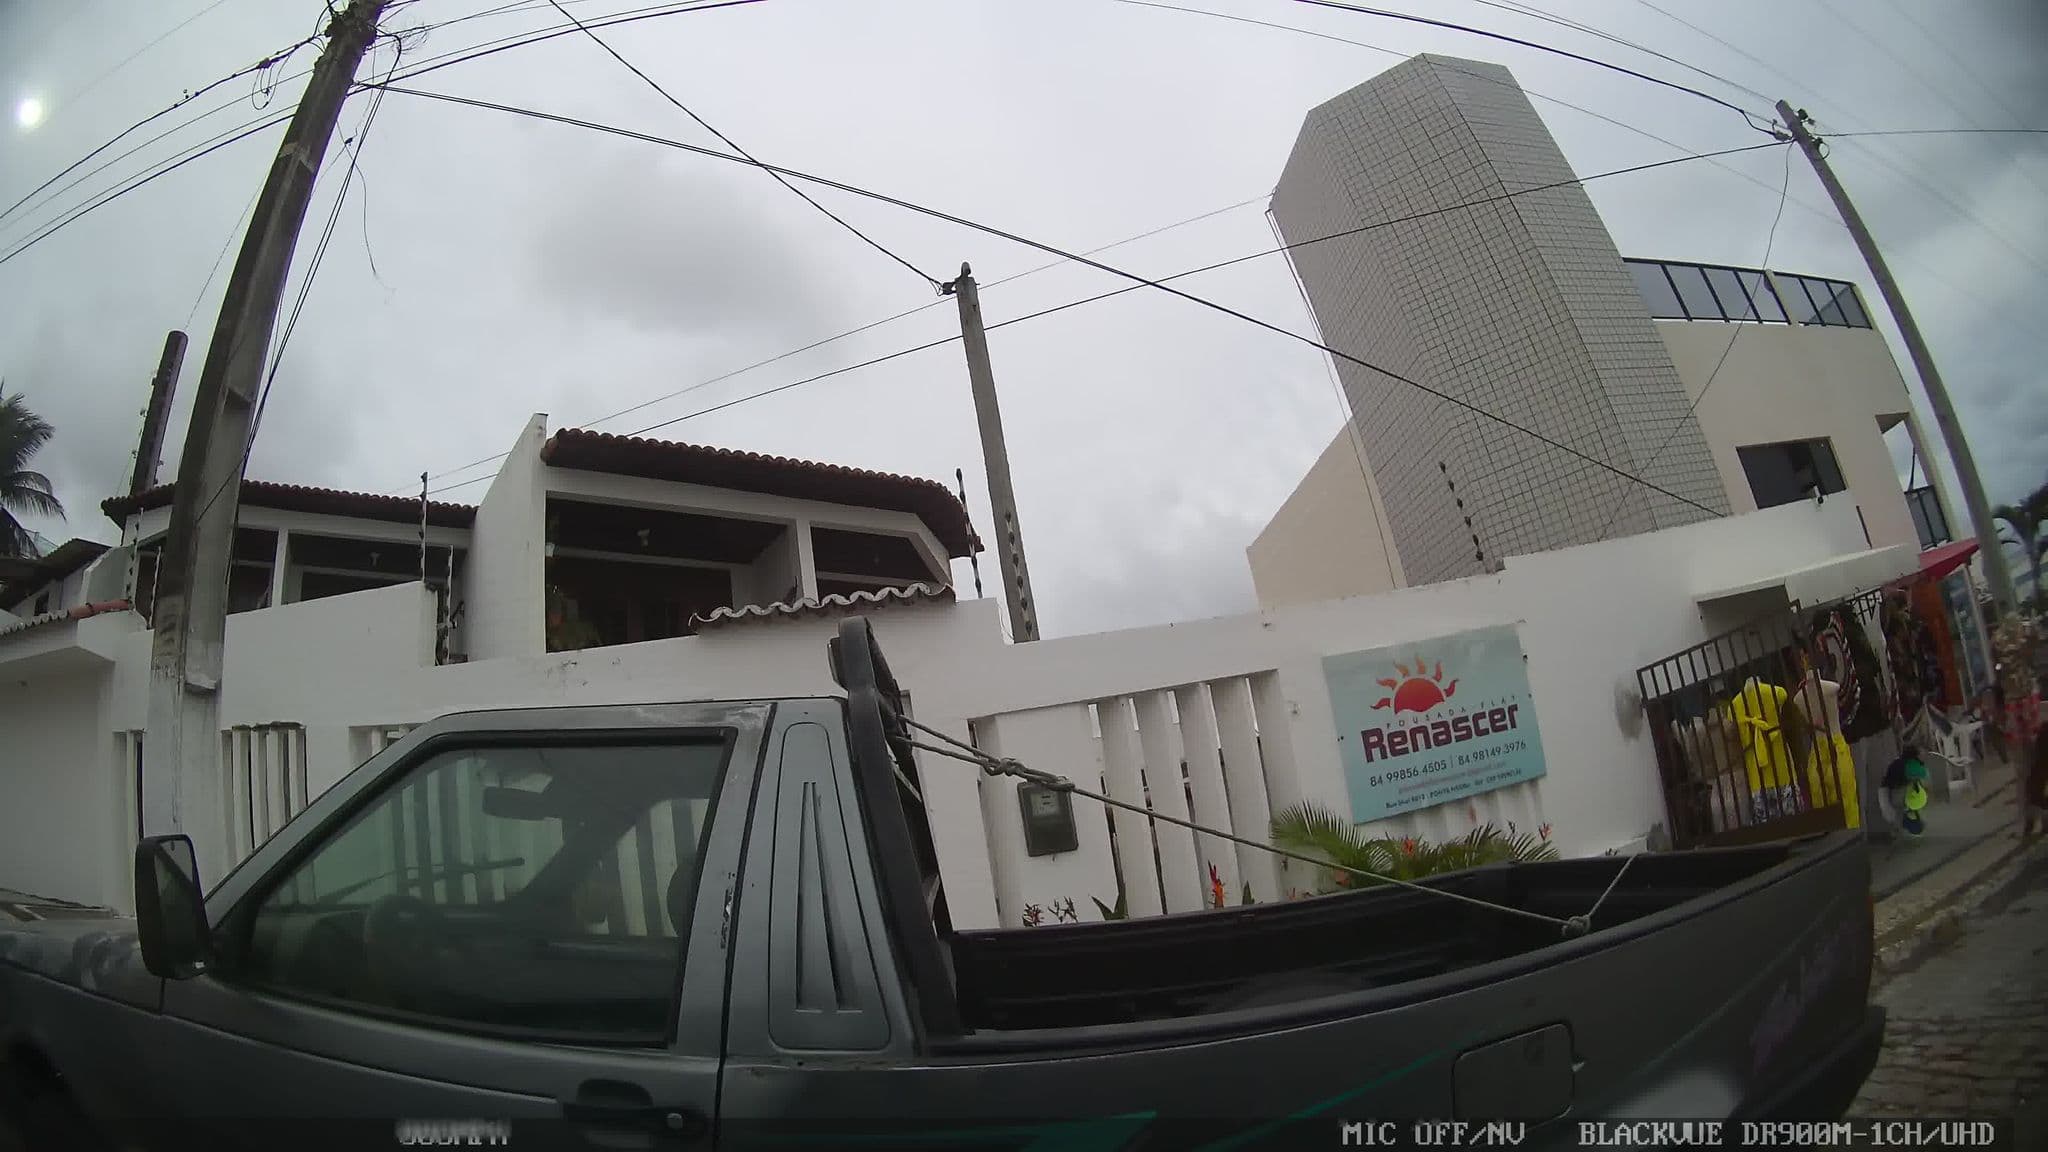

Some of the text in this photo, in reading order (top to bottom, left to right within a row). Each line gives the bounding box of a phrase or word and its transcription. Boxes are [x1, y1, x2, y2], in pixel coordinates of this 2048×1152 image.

[1386, 695, 1517, 729] POUSADA FLAT
[1361, 704, 1519, 763] Renascer
[1369, 775, 1384, 788] 84
